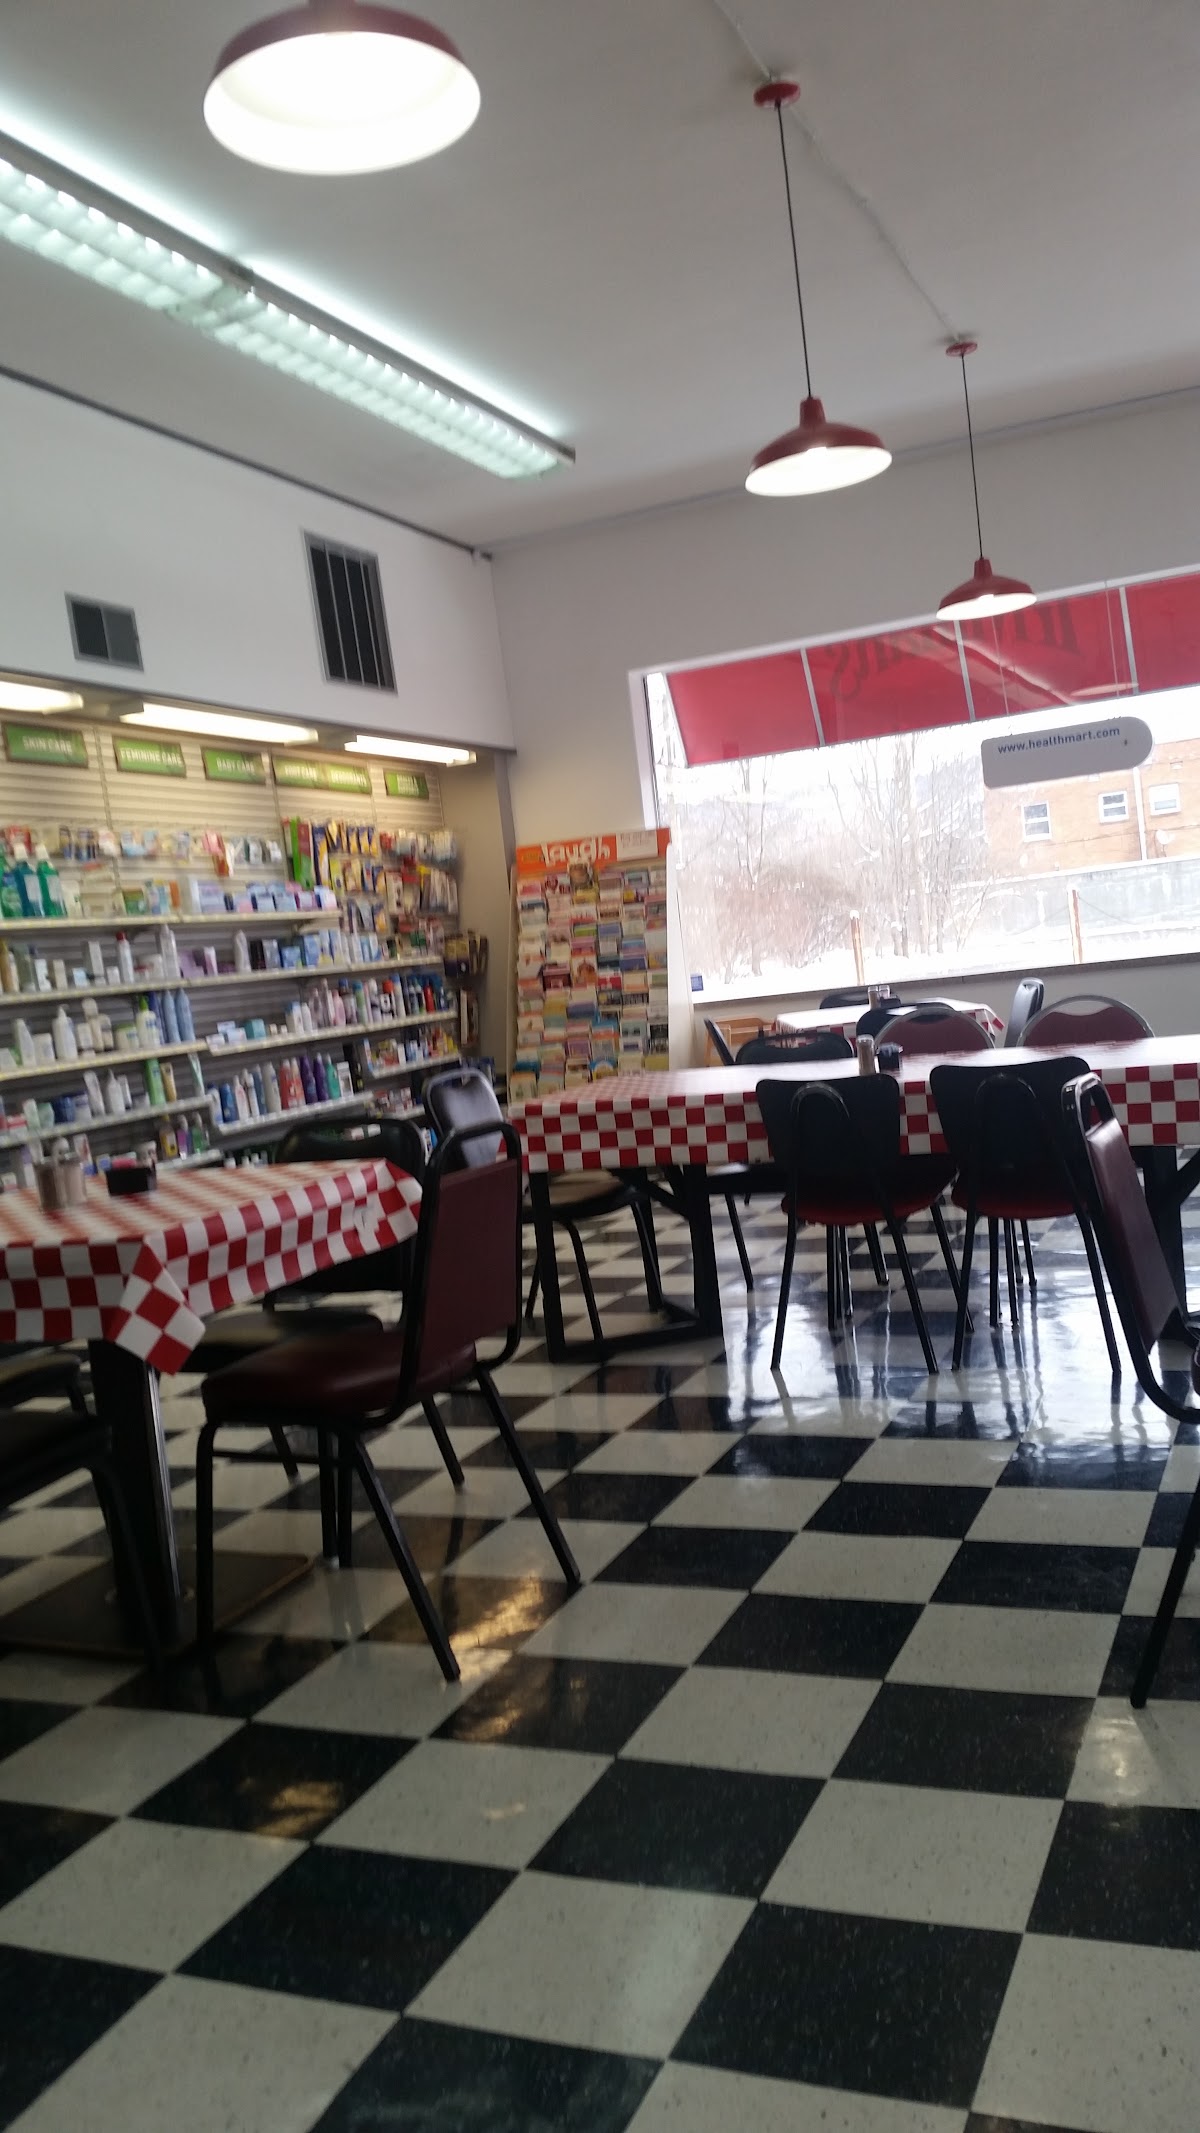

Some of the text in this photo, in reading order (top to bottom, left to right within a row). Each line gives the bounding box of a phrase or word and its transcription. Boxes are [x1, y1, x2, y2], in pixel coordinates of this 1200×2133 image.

[23, 736, 73, 754] SKIN CARE
[998, 727, 1120, 754] www.healthmart.com
[120, 748, 182, 767] FEMININE CARE
[540, 836, 611, 868] laugh
